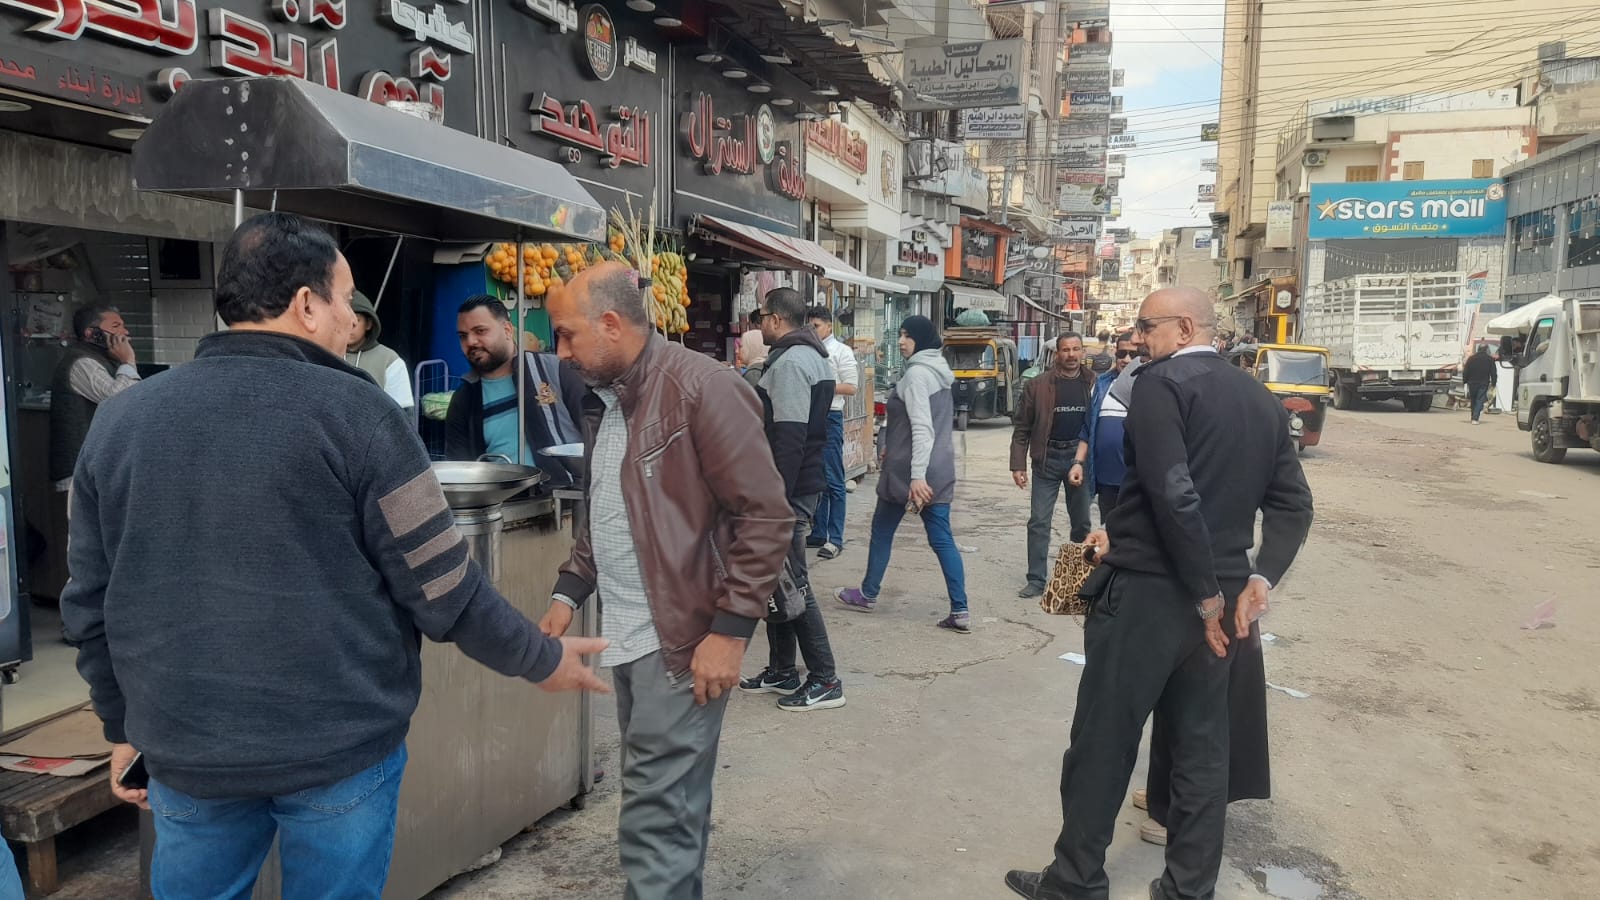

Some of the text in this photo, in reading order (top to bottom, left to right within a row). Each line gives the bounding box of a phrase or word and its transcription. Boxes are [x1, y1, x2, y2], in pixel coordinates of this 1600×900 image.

[910, 54, 1012, 82] التحاليل الطبية
[998, 112, 1024, 125] محمود
[539, 91, 649, 169] التوحيد
[1337, 198, 1485, 220] stars mall
[1372, 222, 1439, 233] متعة التسوق
